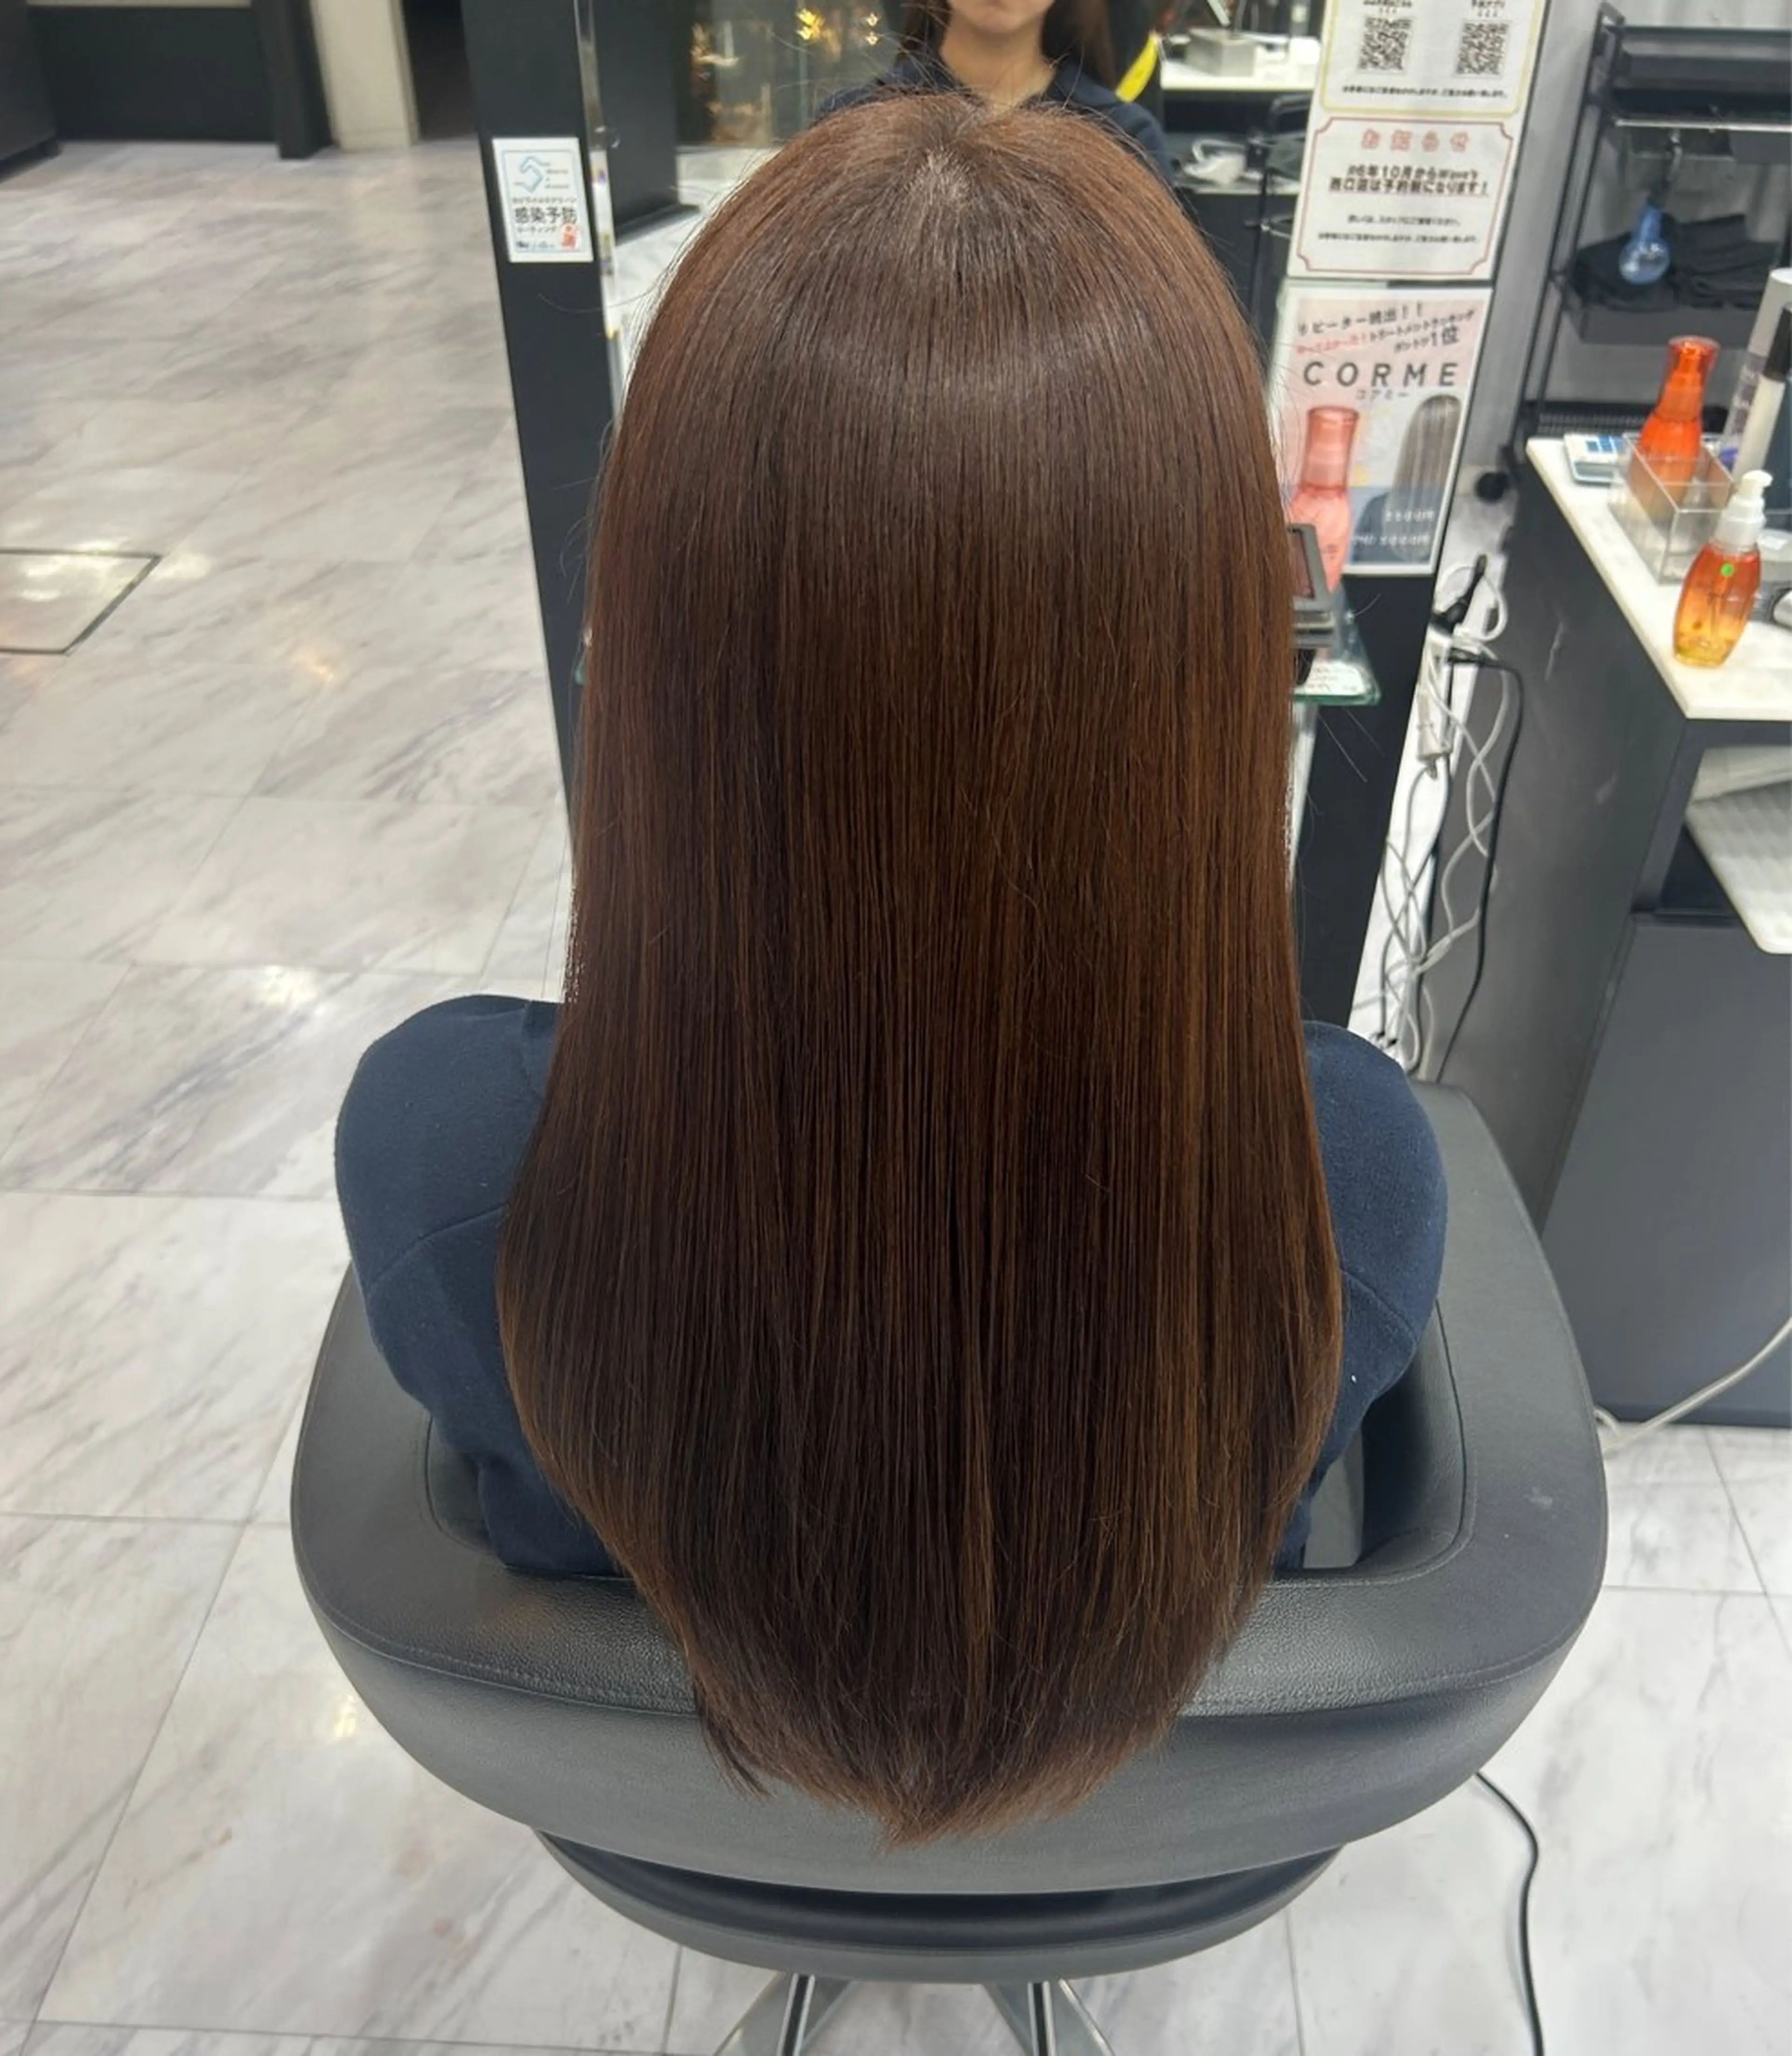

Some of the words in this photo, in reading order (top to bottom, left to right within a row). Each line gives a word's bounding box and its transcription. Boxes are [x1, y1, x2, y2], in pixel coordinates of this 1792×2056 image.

[1362, 129, 1469, 152] お知らせ
[1303, 361, 1458, 387] CORME
